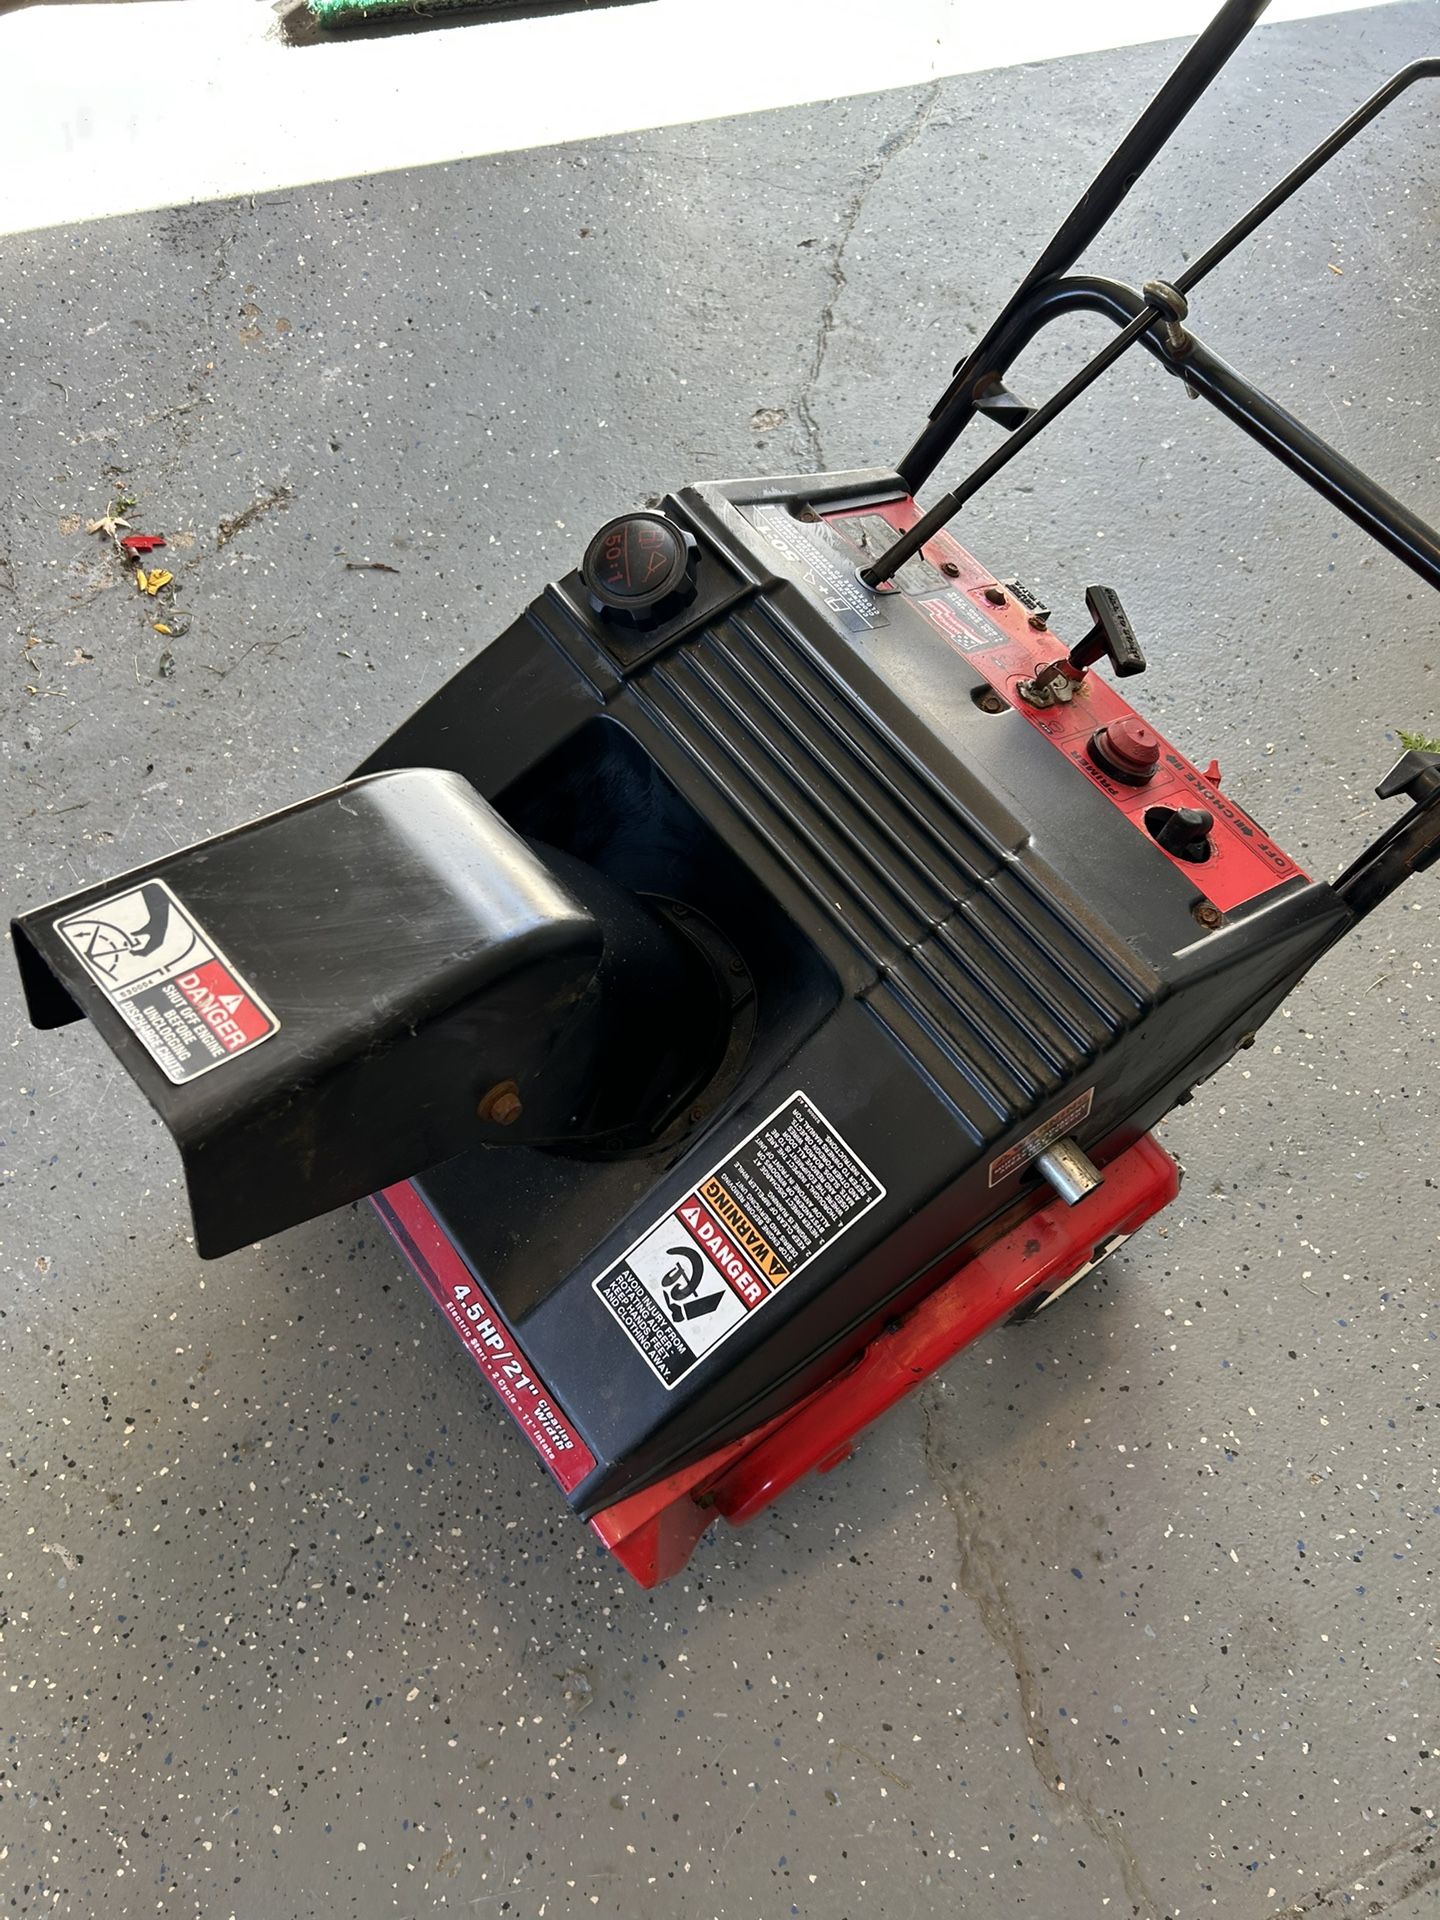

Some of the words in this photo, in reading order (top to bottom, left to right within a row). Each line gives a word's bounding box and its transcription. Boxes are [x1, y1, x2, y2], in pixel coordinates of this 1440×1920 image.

[605, 535, 624, 583] 50:1
[1069, 750, 1119, 795] PRIMER
[1181, 772, 1236, 818] CHOKE
[1256, 842, 1287, 867] OFF
[162, 984, 185, 1004] SHUT
[180, 1007, 201, 1024] OFF
[195, 1027, 225, 1058] ENGINE
[177, 973, 247, 1050] DANGER
[120, 1001, 163, 1048] DISCHARGE
[143, 1006, 191, 1061] UNCLOGGING
[163, 1009, 197, 1045] BEFORE
[792, 1109, 804, 1122] FOR
[765, 1132, 779, 1148] AREA
[771, 1129, 780, 1139] BE
[777, 1137, 786, 1147] TO
[782, 1131, 798, 1149] DOOR
[787, 1126, 804, 1145] WIRES
[791, 1118, 814, 1145] OBJECTS.
[803, 1120, 824, 1145] MANUAL
[754, 1135, 768, 1152] UNIT.
[777, 1147, 788, 1160] THE
[785, 1145, 792, 1153] IS
[796, 1147, 807, 1159] ALL
[753, 1158, 762, 1166] AT
[757, 1150, 766, 1161] OR
[765, 1151, 774, 1160] OF
[803, 1143, 825, 1169] BOARDS,
[812, 1144, 834, 1170] FOREIGN
[821, 1143, 844, 1169] OWNERS
[825, 1134, 860, 1177] INSTRUCTIONS.
[734, 1161, 750, 1181] WHILE
[764, 1159, 787, 1188] WINDOWS
[772, 1159, 790, 1179] FRONT
[786, 1159, 808, 1184] INSPECT
[789, 1152, 818, 1184] EQUIPMENT
[805, 1158, 826, 1183] REMOVE
[823, 1167, 841, 1189] SLEDS,
[832, 1168, 850, 1189] OTHER
[841, 1167, 850, 1178] TO
[721, 1173, 746, 1203] REMOVING
[735, 1181, 748, 1195] UNIT.
[748, 1178, 772, 1207] IMPELLER
[760, 1165, 788, 1199] DISCHARGE
[785, 1186, 795, 1196] OR
[787, 1177, 795, 1185] IN
[815, 1182, 826, 1196] THE
[824, 1182, 837, 1195] AND
[848, 1176, 866, 1196] REFER
[859, 1174, 873, 1191] FULL
[767, 1190, 790, 1218] RUNNING.
[792, 1183, 814, 1207] ANYONE
[805, 1183, 838, 1222] THOROUGHLY
[824, 1194, 843, 1217] WHERE
[834, 1194, 849, 1211] USED
[839, 1187, 855, 1207] MATS,
[848, 1187, 861, 1201] AND
[743, 1201, 764, 1226] BEFORE
[746, 1193, 772, 1224] SERVICING
[769, 1207, 778, 1216] OF
[785, 1197, 804, 1219] DIRECT
[793, 1195, 825, 1234] BYSTANDERS
[811, 1207, 831, 1228] ALLOW
[706, 1181, 770, 1263] WARNING
[769, 1222, 782, 1236] AND
[776, 1214, 794, 1235] CLEAR
[787, 1216, 795, 1224] IS
[802, 1217, 820, 1238] NEVER
[761, 1224, 781, 1247] ENGINE
[791, 1234, 806, 1250] KEEP
[792, 1222, 812, 1246] ENGINE
[778, 1246, 793, 1262] STOP
[779, 1235, 798, 1258] DEBRIS
[697, 1221, 761, 1303] DANGER
[609, 1281, 629, 1304] KEEP
[626, 1304, 651, 1339] HANDS,
[650, 1336, 670, 1360] FEET
[615, 1275, 650, 1319] ROTATING
[647, 1319, 672, 1350] AUGER
[622, 1270, 644, 1297] AVOID
[642, 1295, 668, 1327] INJURY
[664, 1326, 686, 1354] FROM
[603, 1288, 620, 1307] AND
[617, 1306, 651, 1351] CLOTHING
[648, 1350, 671, 1380] AWAY.
[445, 1301, 471, 1337] Electric
[470, 1338, 487, 1362] Start
[498, 1379, 517, 1404] Cycle
[533, 1430, 555, 1459] Intake
[534, 1407, 568, 1450] Width
[538, 1399, 574, 1449] Clearing
